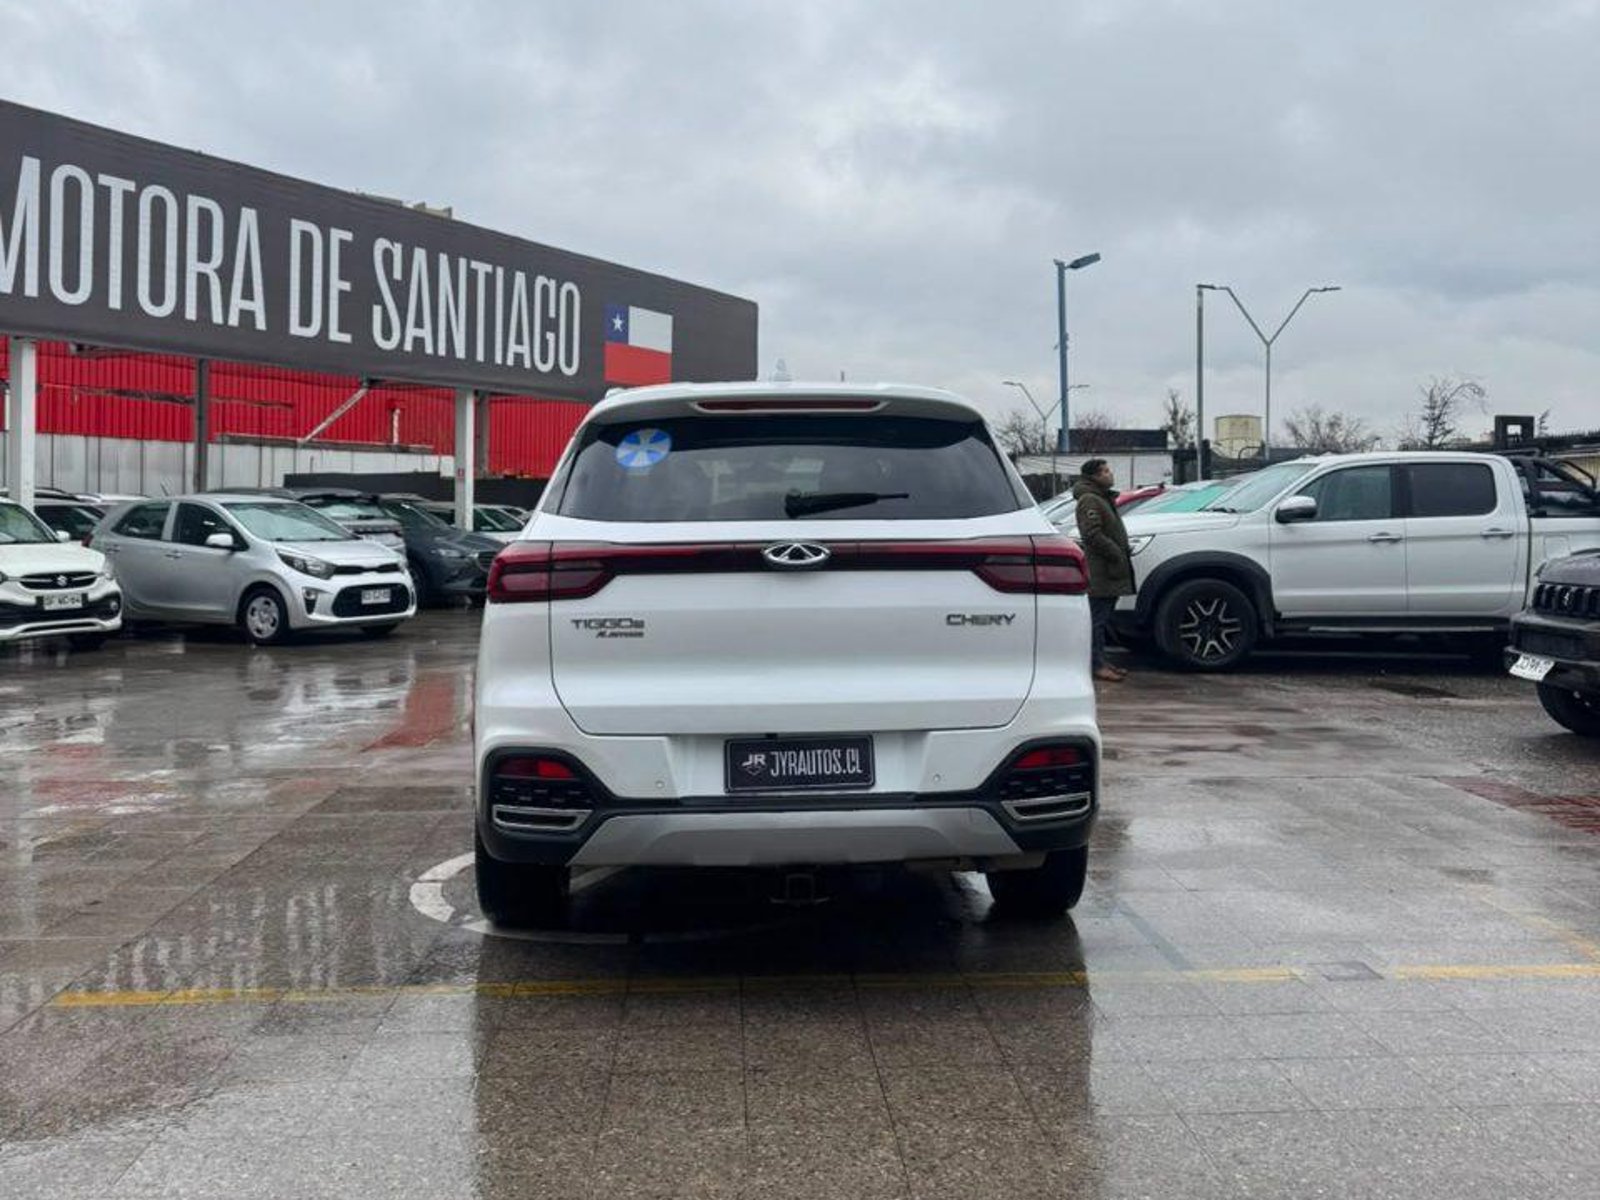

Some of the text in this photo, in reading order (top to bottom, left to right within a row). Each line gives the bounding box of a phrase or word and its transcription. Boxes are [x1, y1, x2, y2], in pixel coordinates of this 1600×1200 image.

[289, 218, 353, 344] DE
[372, 237, 580, 376] SANTIAGO
[946, 613, 1016, 626] CHERY
[770, 748, 863, 776] JYRAUTOS.CL
